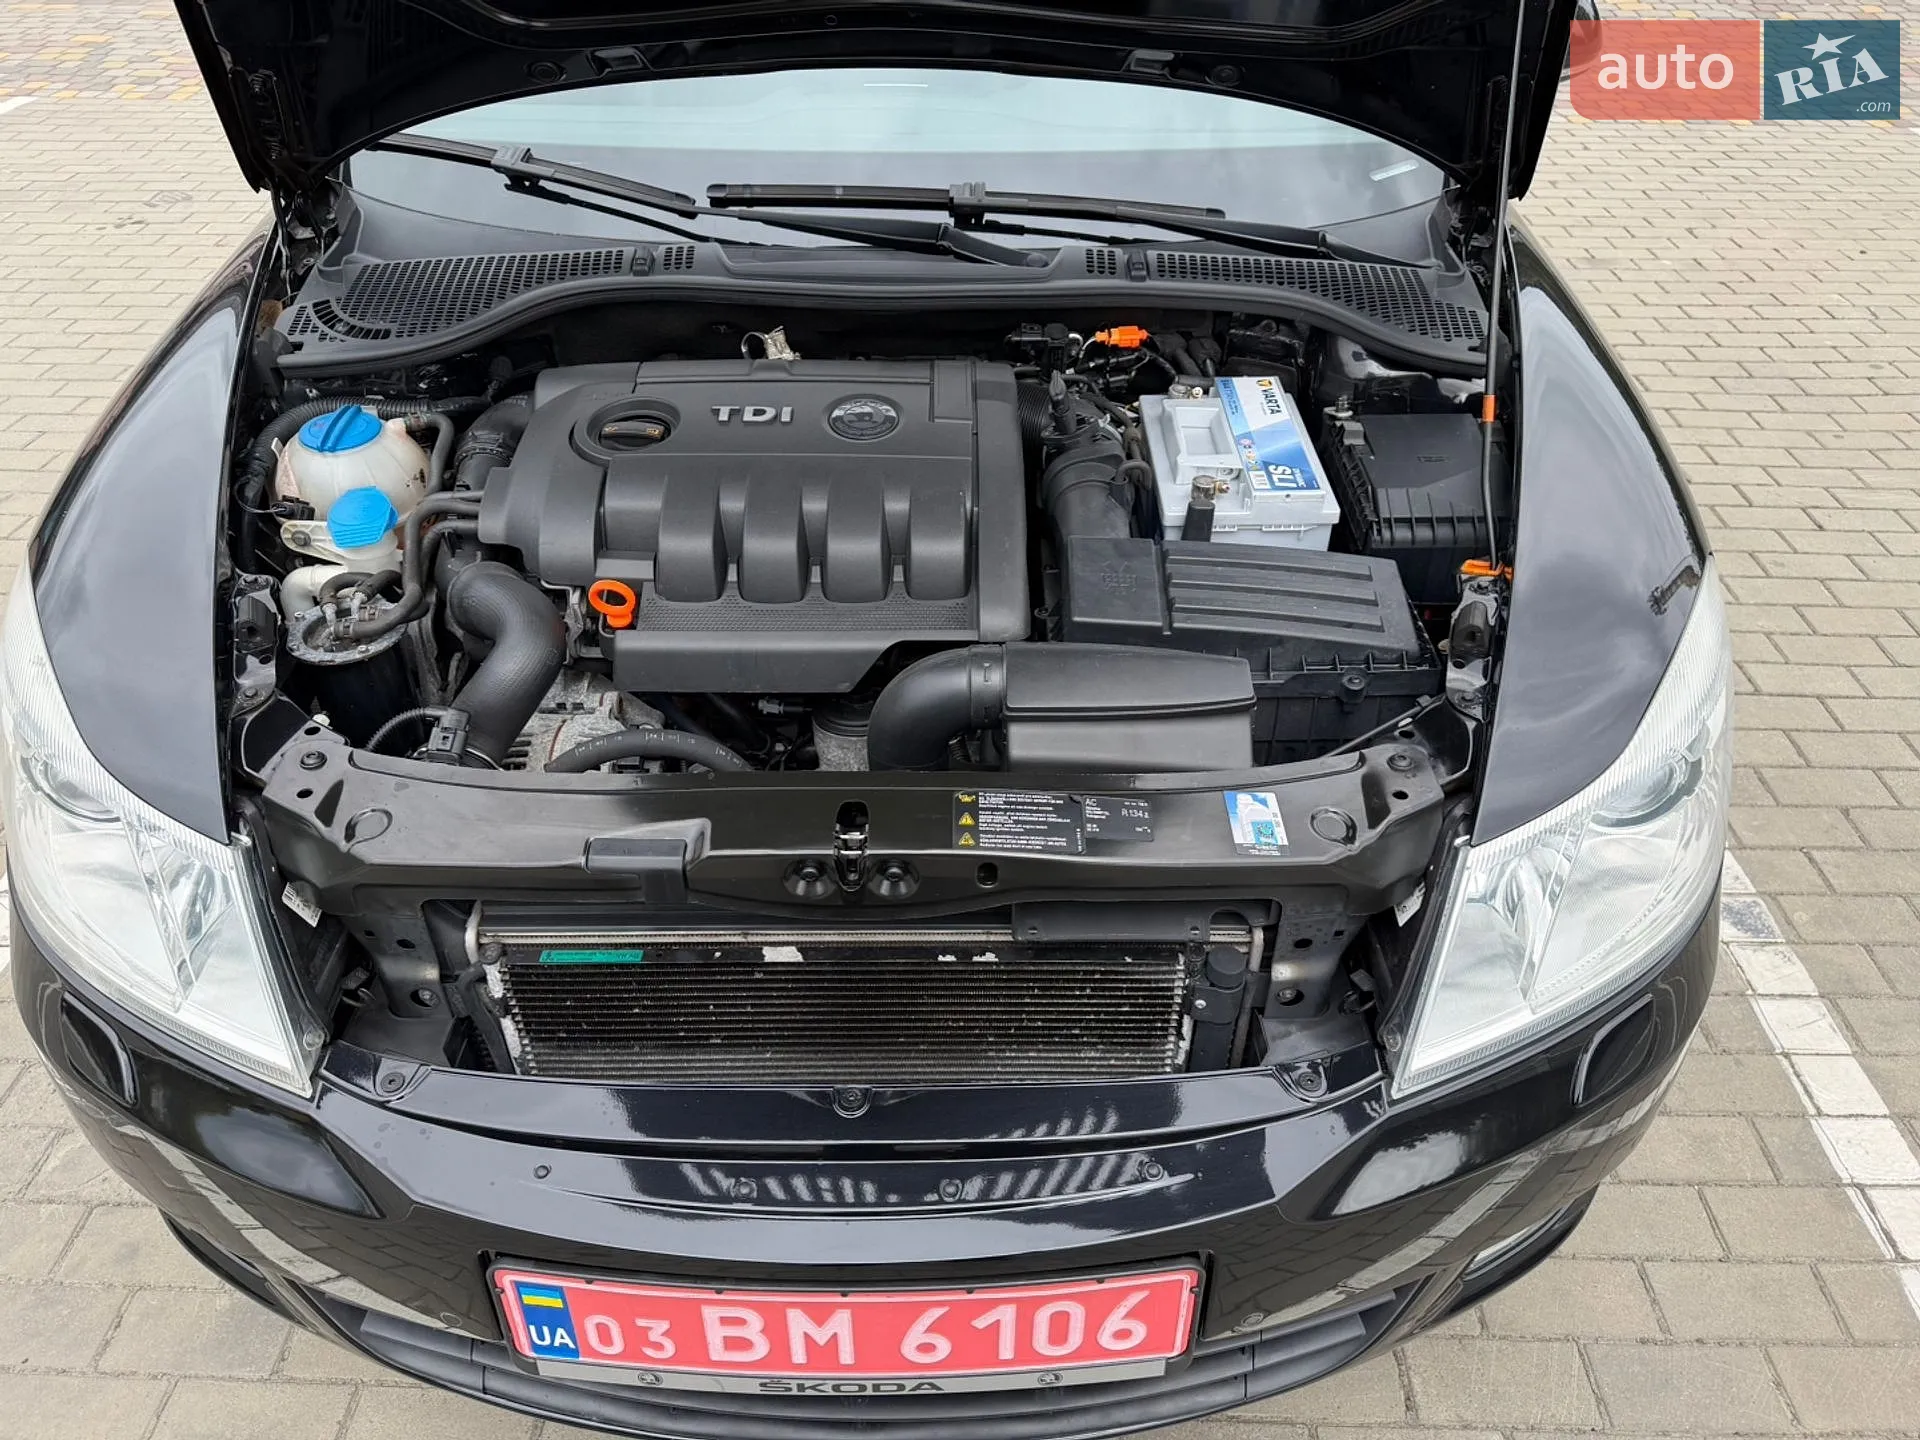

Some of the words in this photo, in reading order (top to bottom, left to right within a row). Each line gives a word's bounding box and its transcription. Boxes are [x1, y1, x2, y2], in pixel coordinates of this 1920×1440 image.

[1261, 387, 1282, 415] VARTA
[711, 406, 793, 423] TDI
[1268, 464, 1297, 488] SLI
[528, 1324, 576, 1350] UA
[583, 1314, 677, 1360] 03
[701, 1303, 856, 1366] BM
[899, 1290, 1150, 1365] 6106
[758, 1378, 946, 1394] ŠKODA
